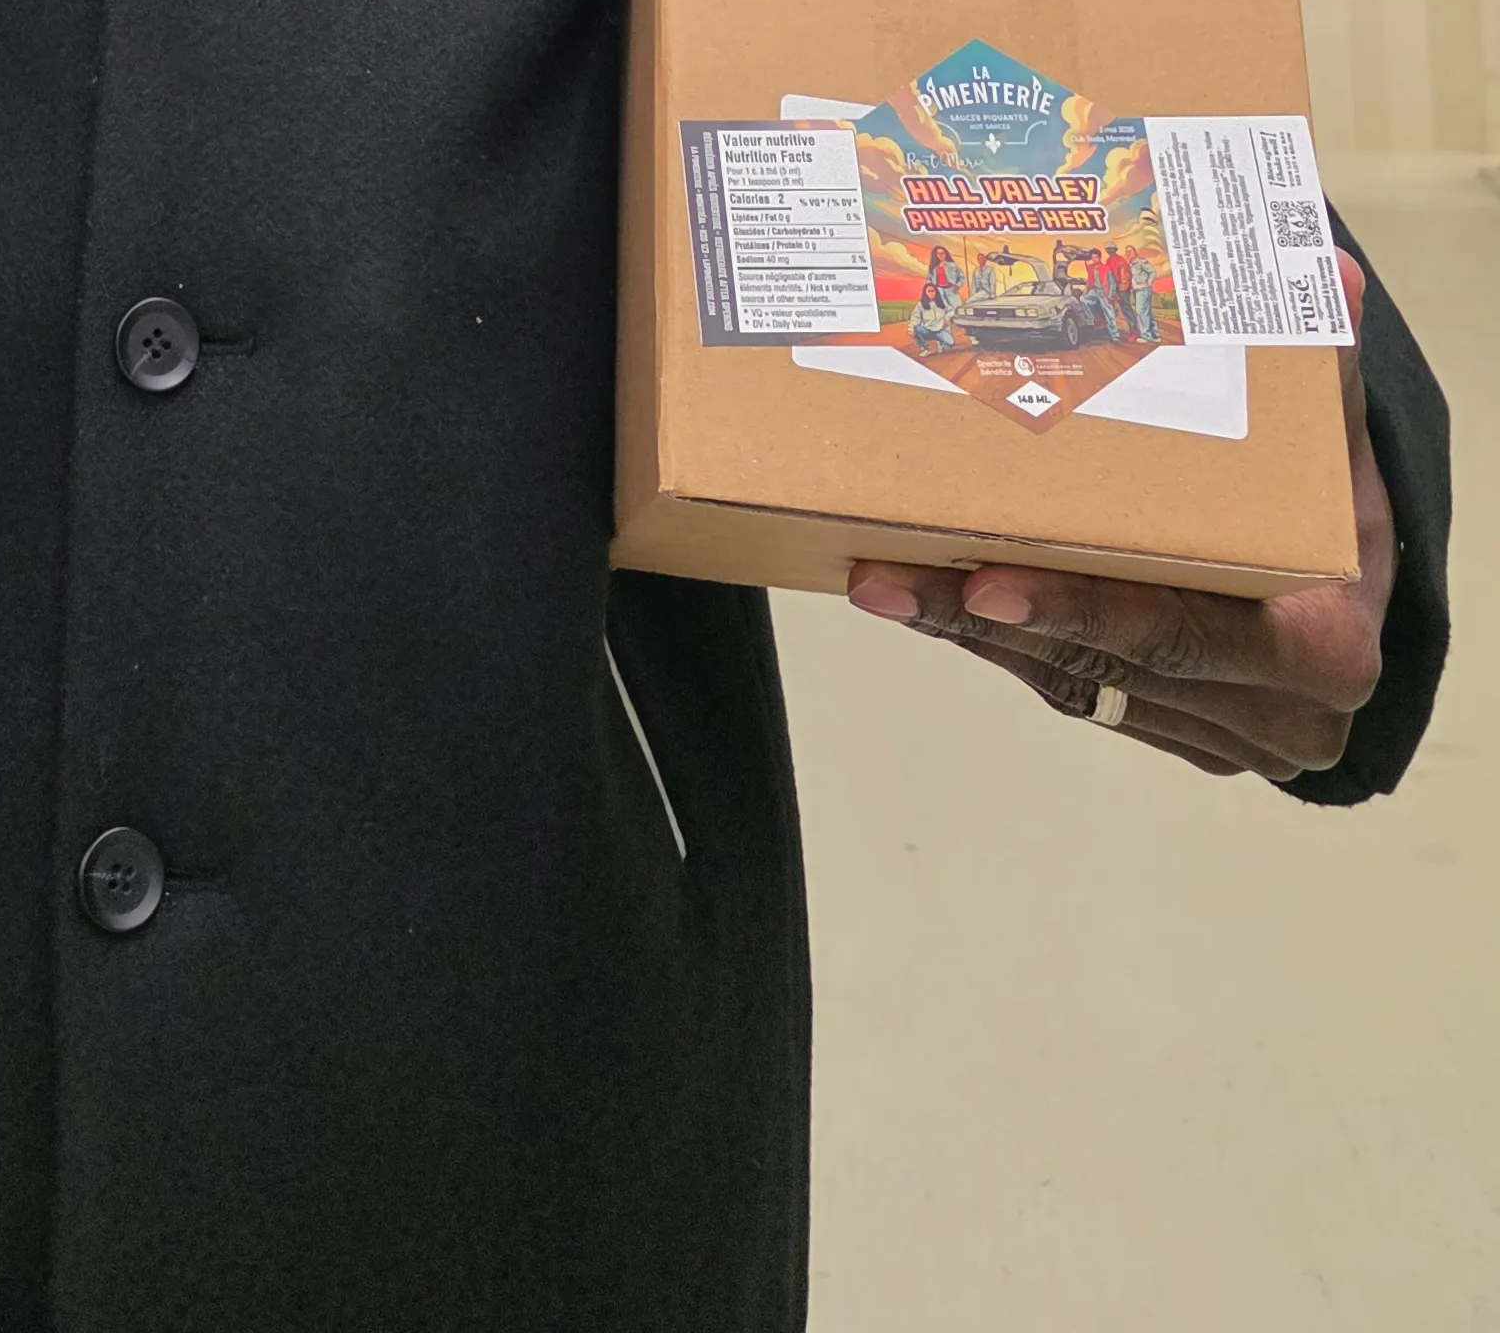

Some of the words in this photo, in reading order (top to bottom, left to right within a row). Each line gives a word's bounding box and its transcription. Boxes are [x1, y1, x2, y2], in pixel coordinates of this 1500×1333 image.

[973, 66, 990, 80] LA
[918, 75, 1055, 116] PIMENTERIE
[722, 134, 762, 146] Valeur
[765, 134, 815, 145] nutritive
[724, 150, 777, 162] Nutrition
[780, 150, 812, 162] Facts
[903, 177, 983, 204] HILL
[980, 176, 1097, 204] VALLEY
[729, 193, 770, 203] Calories
[778, 194, 784, 203] 2
[904, 207, 1042, 232] PINEAPPLE
[1039, 207, 1107, 232] HEAT
[1017, 395, 1033, 404] 148
[1036, 395, 1051, 404] ML
